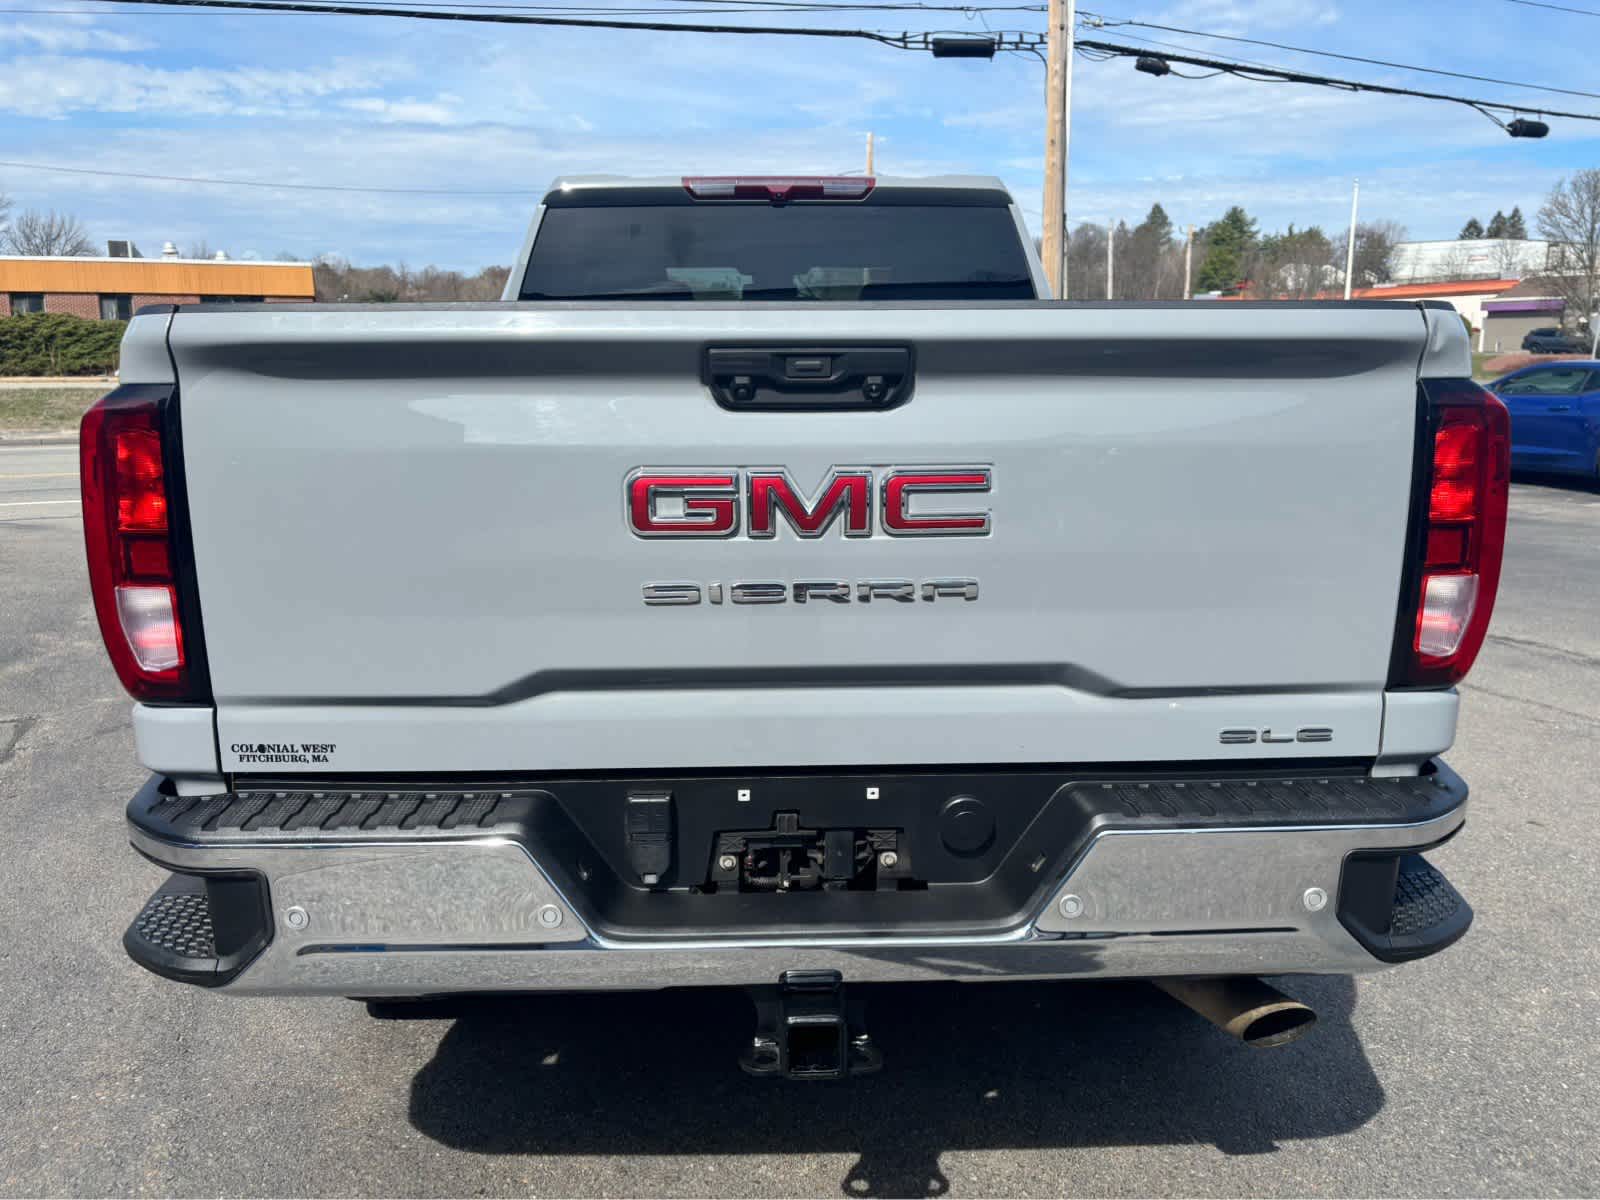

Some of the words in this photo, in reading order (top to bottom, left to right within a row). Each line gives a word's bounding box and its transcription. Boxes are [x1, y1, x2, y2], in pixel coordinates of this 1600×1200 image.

[625, 465, 992, 540] GMC
[641, 577, 979, 605] SIERRA
[1220, 728, 1333, 744] SLE
[301, 743, 337, 754] WEST
[239, 754, 310, 764] FITCHBURG,
[311, 754, 329, 763] MA
